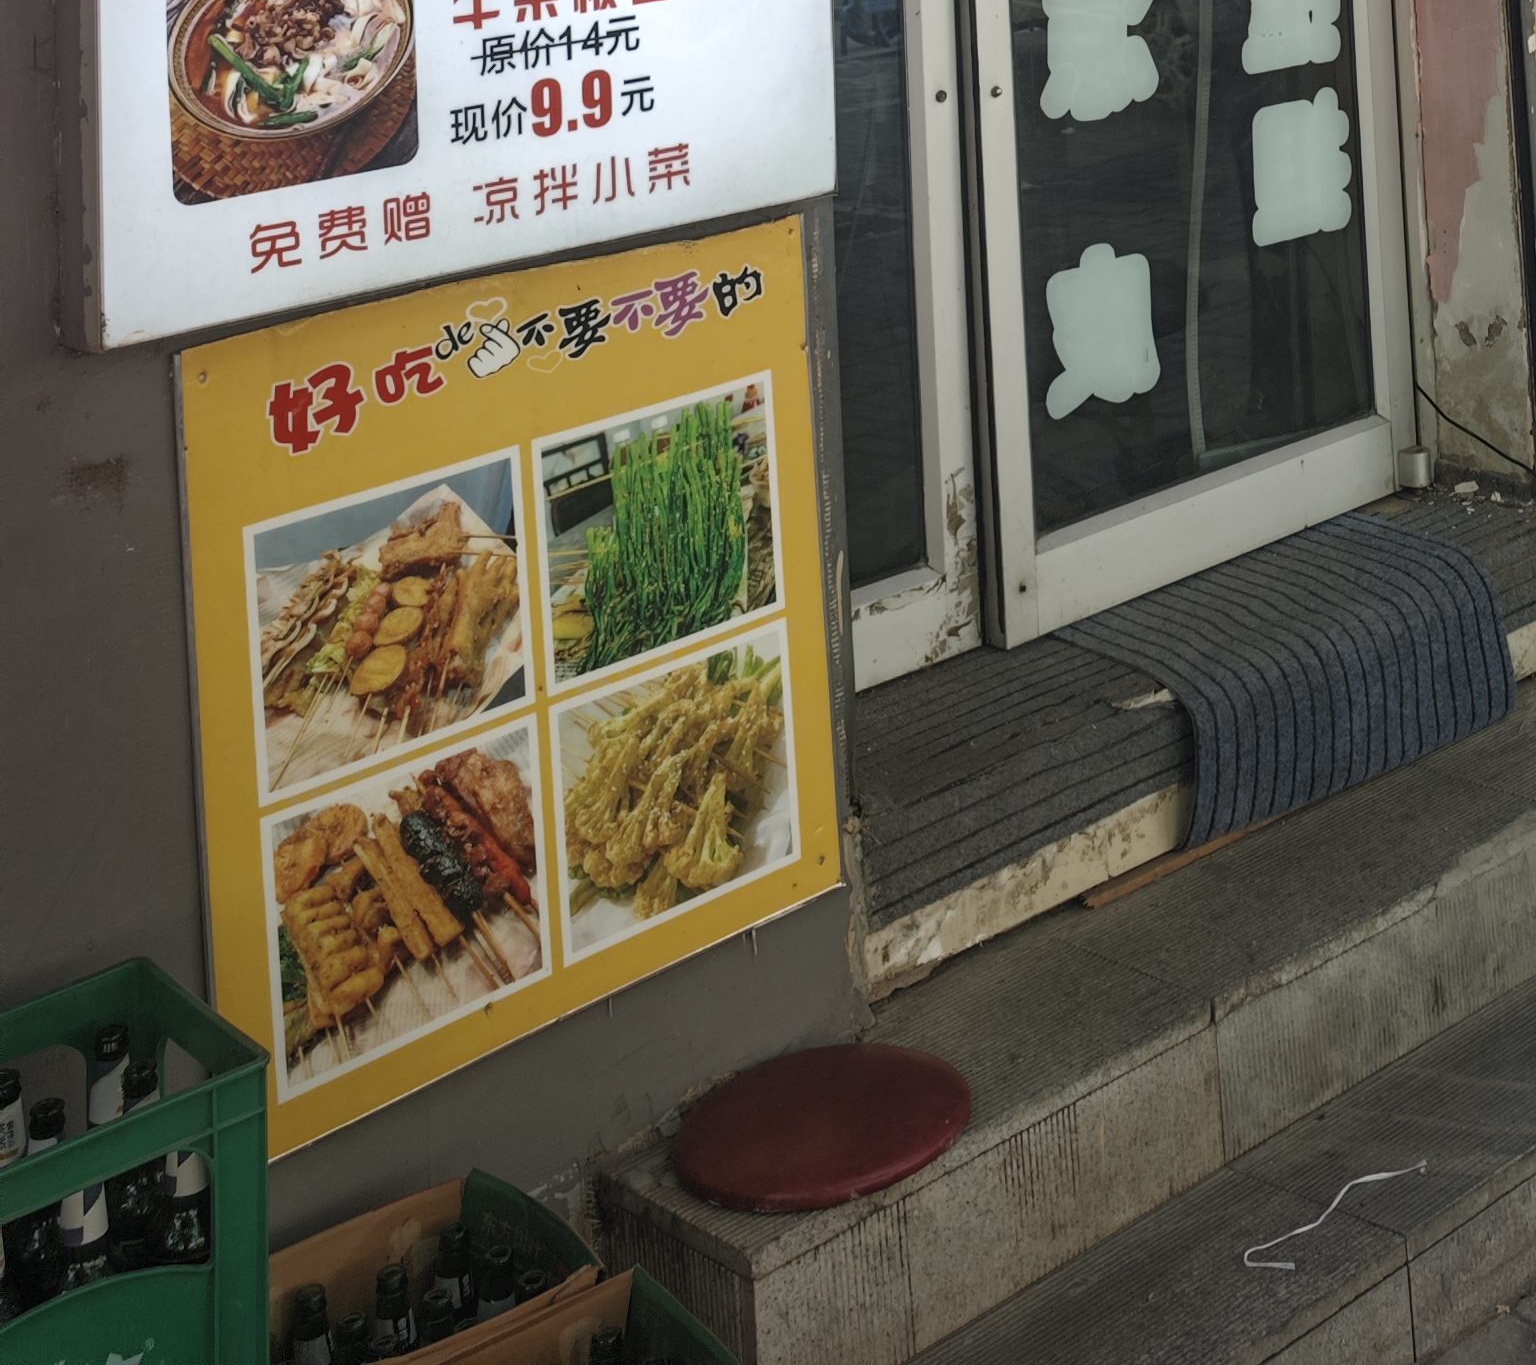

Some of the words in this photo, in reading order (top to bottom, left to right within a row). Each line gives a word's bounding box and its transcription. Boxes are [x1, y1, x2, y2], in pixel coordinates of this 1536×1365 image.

[479, 16, 641, 76] 原价14元
[450, 69, 655, 145] 现价9.9元
[249, 190, 432, 274] 免费赠
[473, 143, 692, 226] 凉拌小菜
[516, 266, 764, 358] 不要不要的
